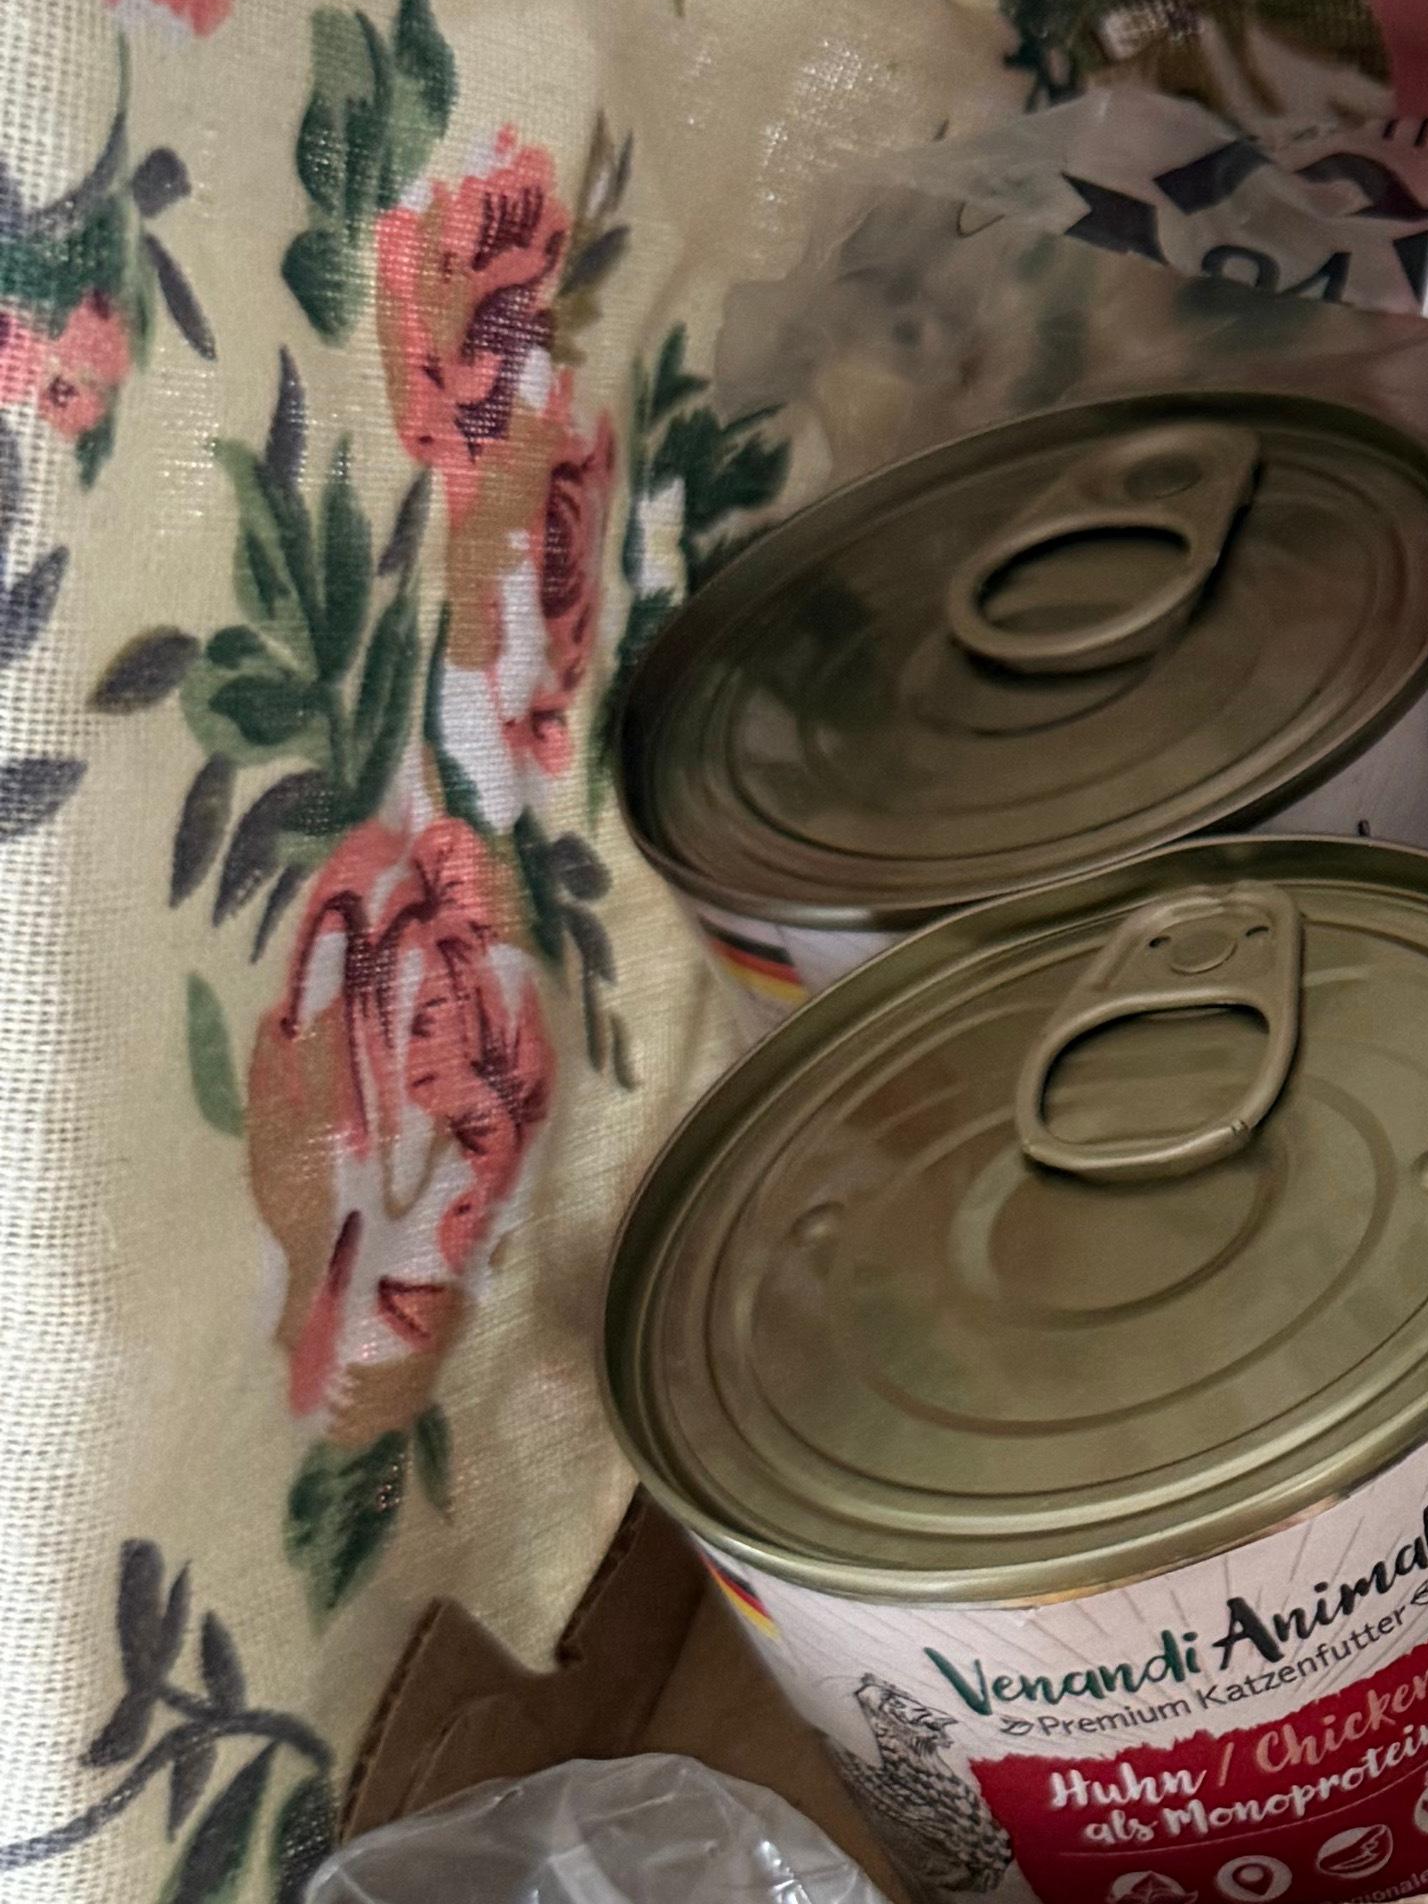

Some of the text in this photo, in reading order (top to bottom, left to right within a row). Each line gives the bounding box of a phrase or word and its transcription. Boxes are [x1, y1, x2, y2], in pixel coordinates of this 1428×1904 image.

[924, 1629, 1203, 1716] Venandi
[1042, 1603, 1408, 1736] Premium Katzenfutter
[1048, 1762, 1207, 1811] Huhn
[1083, 1810, 1159, 1846] als
